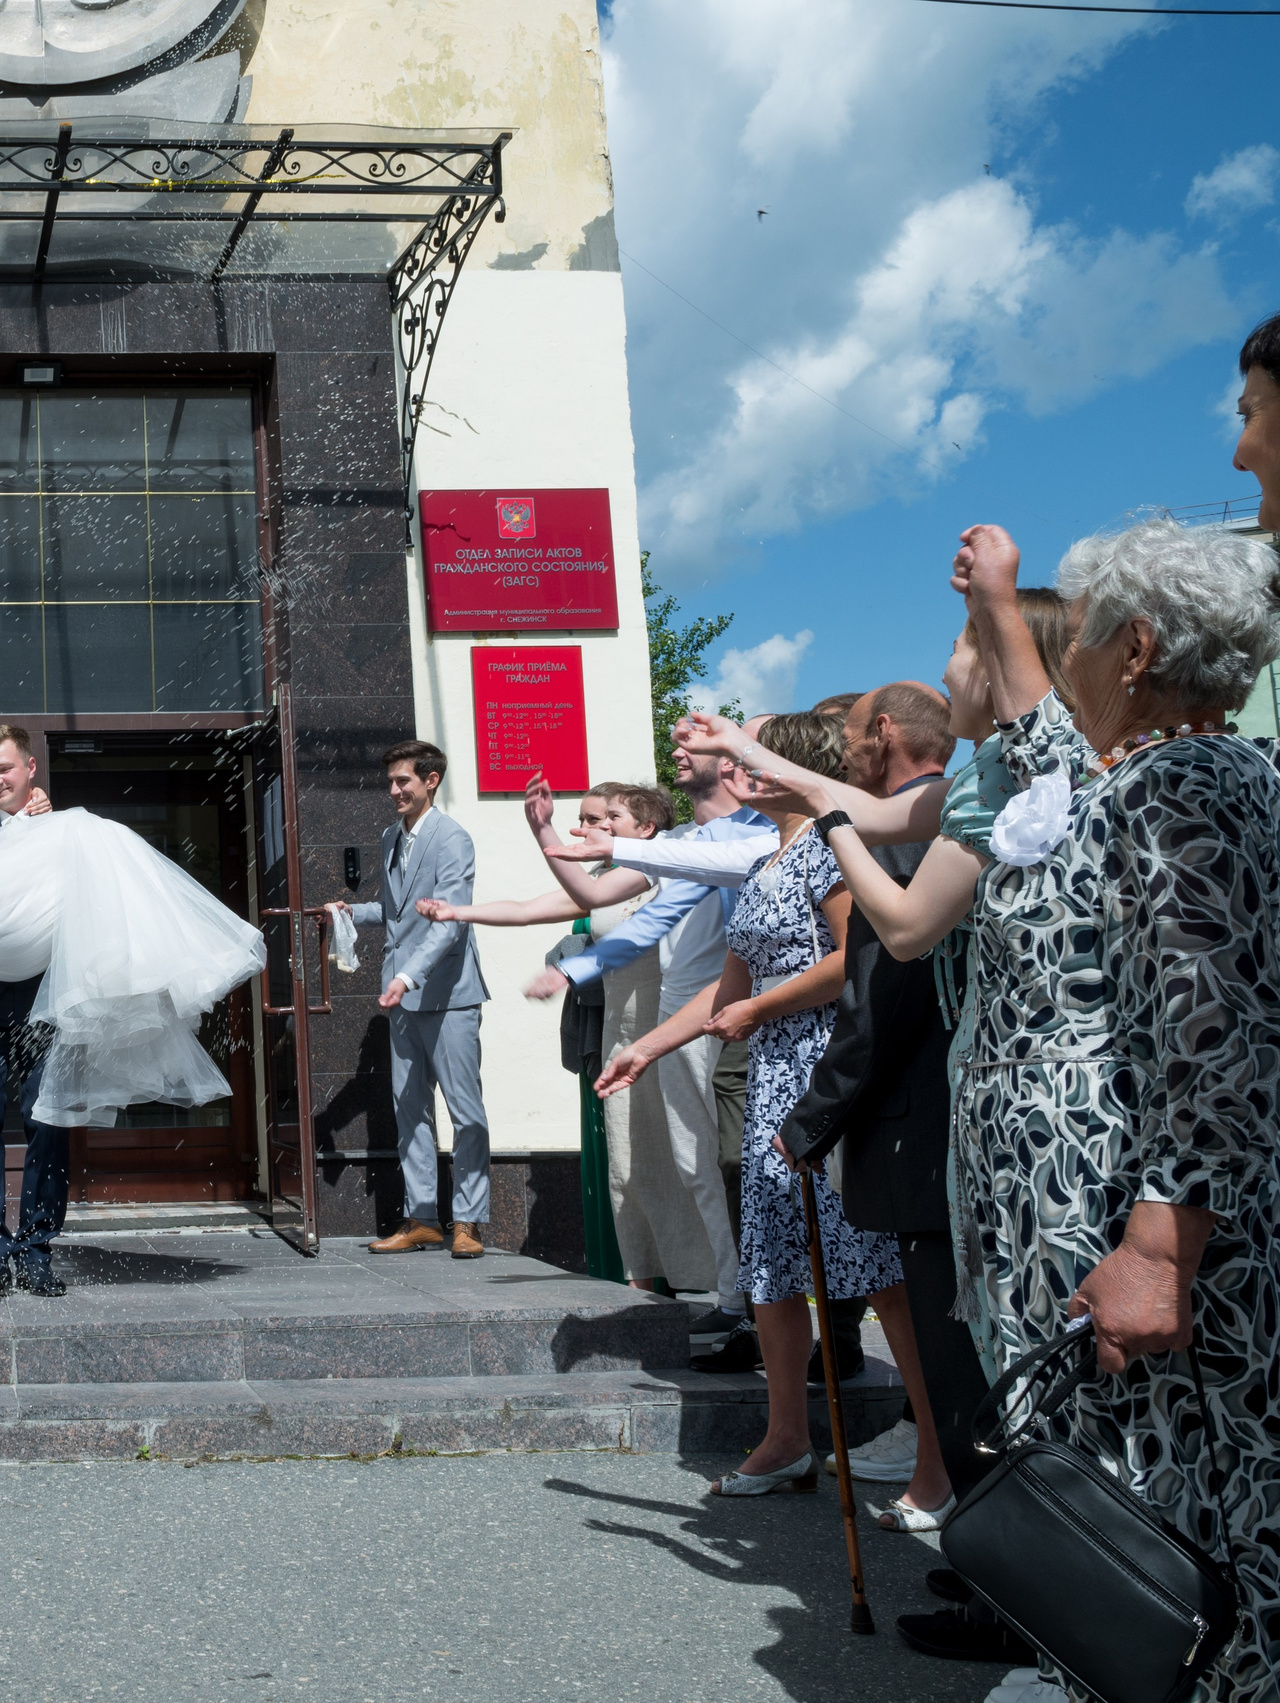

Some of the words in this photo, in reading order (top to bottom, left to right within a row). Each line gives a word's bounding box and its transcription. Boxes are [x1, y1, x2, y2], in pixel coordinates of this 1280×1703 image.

[455, 549, 492, 561] ОТДЕЛ
[494, 548, 543, 558] ЗАПИСИ
[546, 547, 582, 558] АКТОВ
[434, 561, 529, 575] ГРАЖДАНСКОГО
[531, 561, 606, 572] СОСТОЯНИЯ
[502, 575, 540, 588] (ЗАГС)
[444, 609, 498, 617] Администрация
[499, 608, 555, 616] муниципального
[556, 607, 602, 615] образования
[488, 662, 525, 672] ГРАФИК
[527, 661, 567, 672] ПРИЁМА
[506, 674, 551, 684] ГРАЖДАН
[489, 752, 501, 760] СБ
[505, 763, 544, 771] выходной
